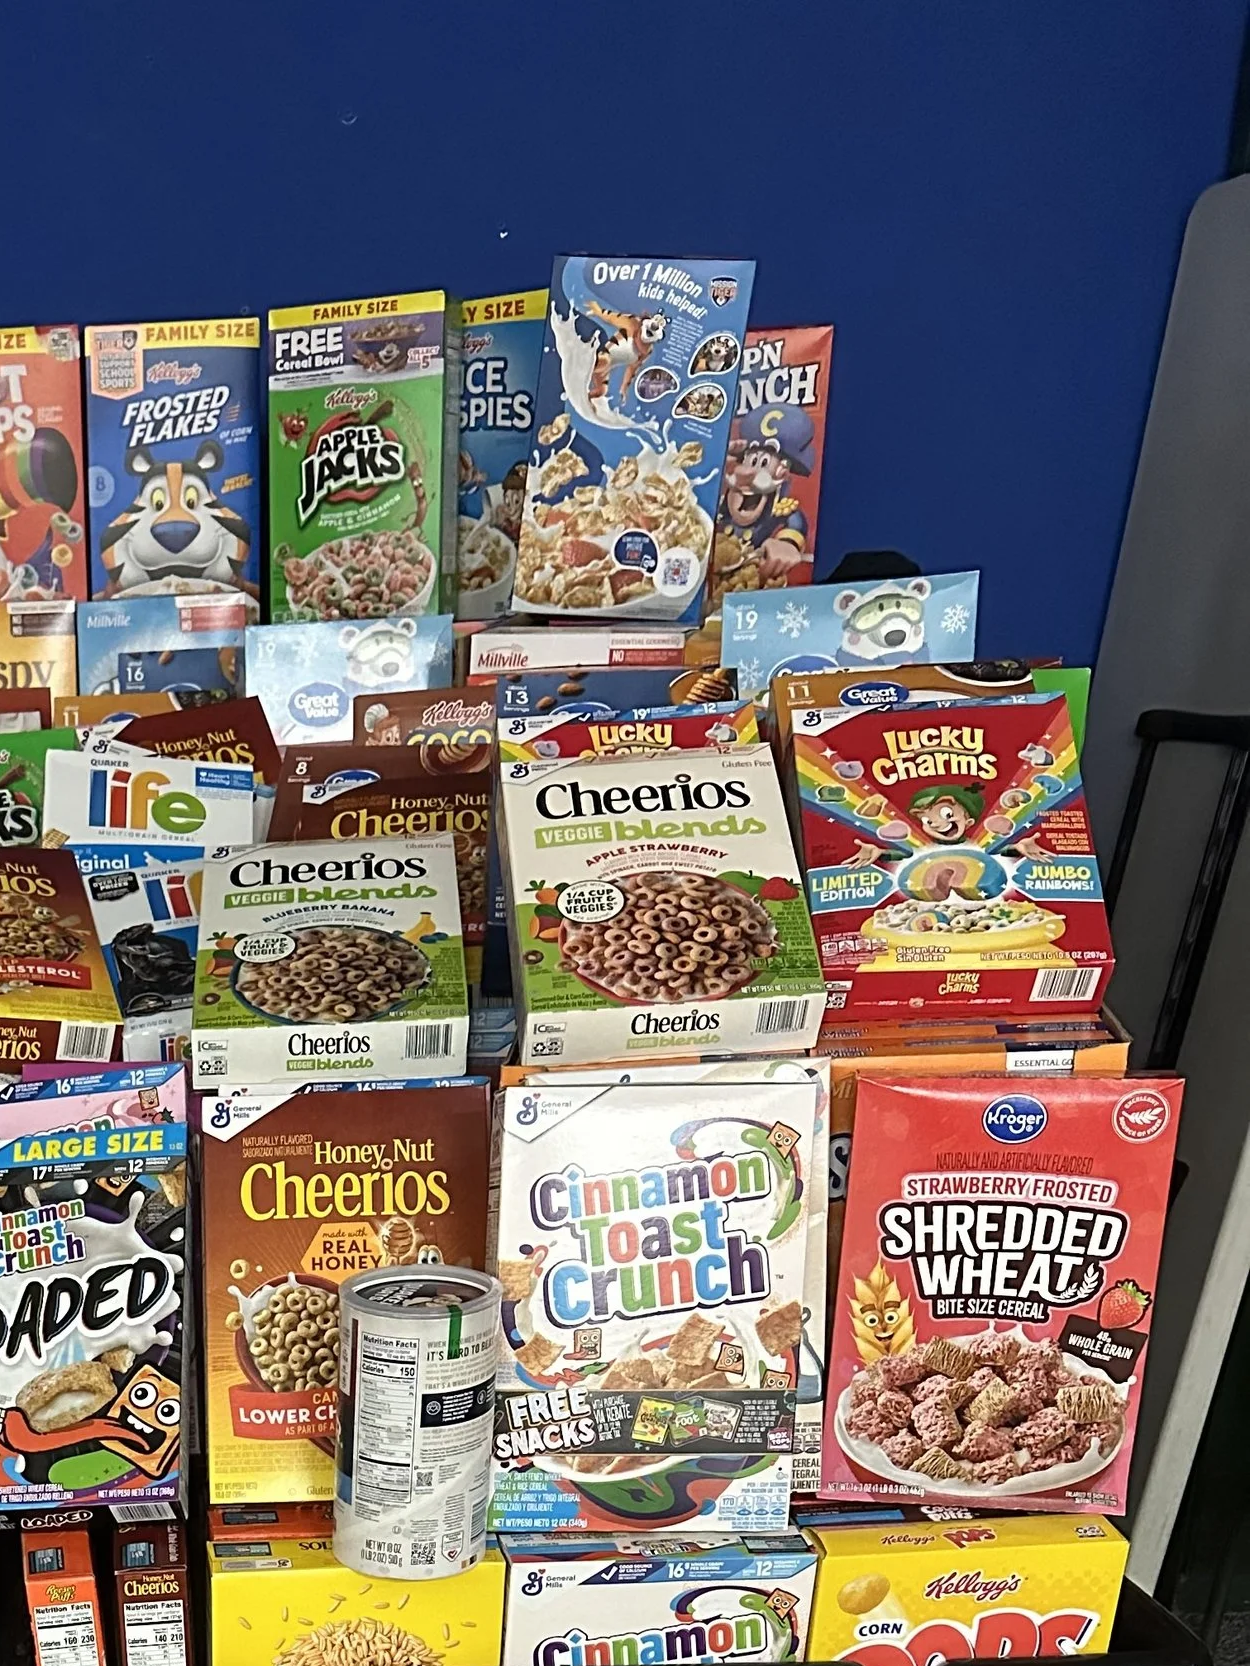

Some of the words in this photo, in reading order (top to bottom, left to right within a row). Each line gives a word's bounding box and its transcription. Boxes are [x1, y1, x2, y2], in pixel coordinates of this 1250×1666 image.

[594, 262, 639, 285] Over
[644, 263, 653, 279] 1
[653, 266, 703, 298] Million
[312, 302, 361, 321] FAMILY
[366, 299, 399, 316] SIZE
[637, 283, 664, 301] kids
[666, 291, 706, 320] helped!
[146, 326, 211, 341] FAMILY
[216, 323, 255, 338] SIZE
[276, 327, 343, 359] FREE
[276, 357, 311, 371] Cereal
[314, 352, 344, 368] Bowl
[122, 386, 229, 426] FROSTED
[324, 389, 378, 409] Kellogg's
[129, 412, 219, 448] FLAKES
[319, 426, 379, 453] APPLE
[299, 444, 401, 517] JACKS
[735, 611, 758, 630] 19
[883, 726, 984, 760] Lucky
[91, 759, 128, 768] QUAKER
[872, 751, 998, 786] Charms
[89, 769, 207, 834] life
[535, 774, 751, 820] Cheerios
[542, 826, 604, 844] VEGGIE
[616, 815, 766, 841] blends
[4, 859, 39, 875] Nut
[586, 847, 626, 867] APPLE
[630, 843, 729, 860] STRAWBERRY
[230, 853, 426, 887] Cheerios
[813, 873, 882, 892] LIMITED
[1026, 865, 1091, 882] JUMBO
[231, 891, 286, 905] VEGGIE
[298, 883, 437, 903] blends
[567, 890, 586, 899] 1/4
[588, 889, 614, 898] CUP
[820, 887, 875, 901] EDITION
[1025, 879, 1094, 891] RAINBOWS!
[263, 904, 337, 923] BLUEBERRY
[342, 903, 395, 917] BANANA
[565, 902, 614, 914] VEGGIES
[567, 897, 603, 905] FRUIT
[608, 895, 615, 903] &
[988, 1103, 1044, 1134] Kroger
[14, 1136, 97, 1162] LARGE
[107, 1130, 163, 1153] SIZE
[315, 1141, 385, 1169] Honey
[393, 1139, 434, 1162] Nut
[240, 1161, 450, 1221] Cheerios
[539, 1154, 765, 1223] Cinnamon
[908, 1177, 1028, 1199] STRAWBERRY
[1032, 1178, 1112, 1203] FROSTED
[580, 1201, 725, 1266] Toast
[884, 1204, 1123, 1258] SHREDDED
[323, 1240, 372, 1254] REAL
[312, 1255, 382, 1271] HONEY
[916, 1252, 1082, 1301] WHEAT
[553, 1235, 765, 1321] Crunch
[937, 1299, 964, 1314] BITE
[968, 1300, 995, 1316] SIZE
[998, 1301, 1044, 1319] CEREAL
[507, 1387, 592, 1430] FREE
[494, 1418, 595, 1459] SNACKS
[926, 1571, 1021, 1601] Kellogg's
[858, 1622, 902, 1638] CORN
